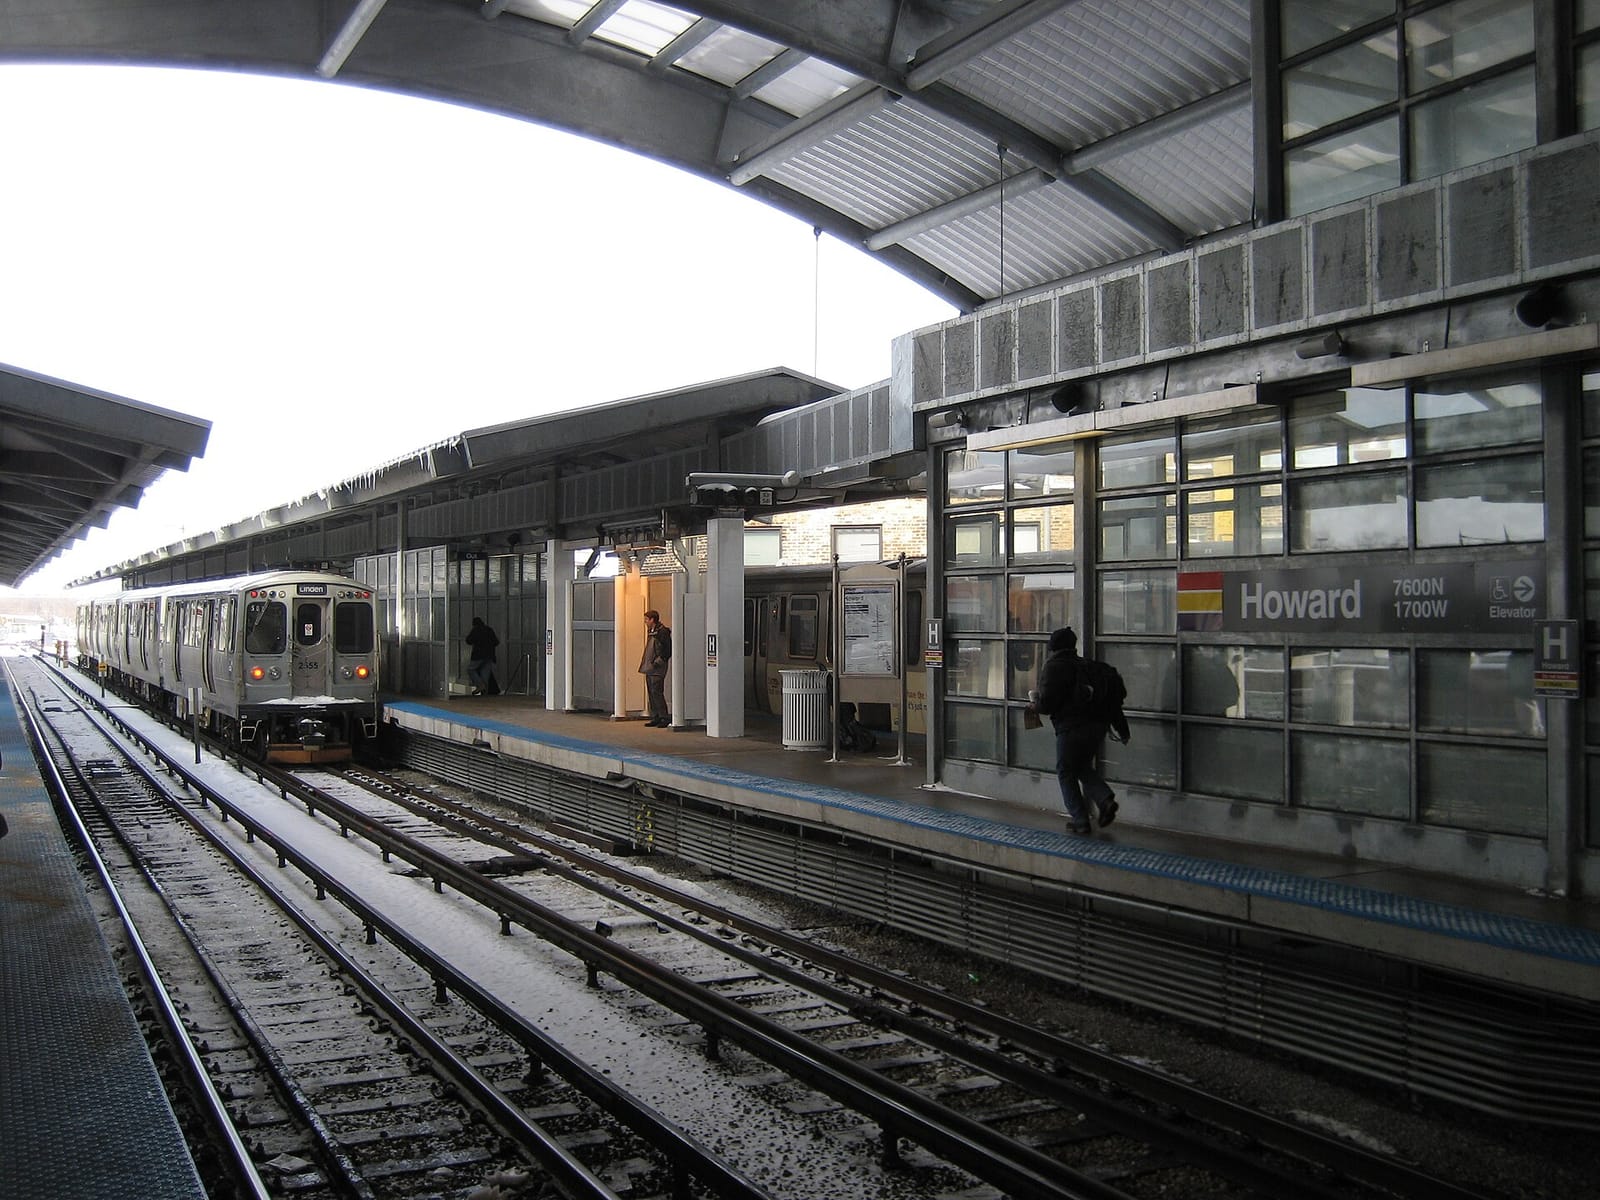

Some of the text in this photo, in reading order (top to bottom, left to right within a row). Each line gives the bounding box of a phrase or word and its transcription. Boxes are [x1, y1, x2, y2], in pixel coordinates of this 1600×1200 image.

[1392, 577, 1444, 596] 7600N
[1240, 579, 1361, 619] Howard
[1393, 600, 1448, 618] 1700W
[1488, 606, 1536, 618] Elevator
[928, 623, 938, 644] H
[1543, 626, 1567, 660] H
[708, 636, 715, 652] H
